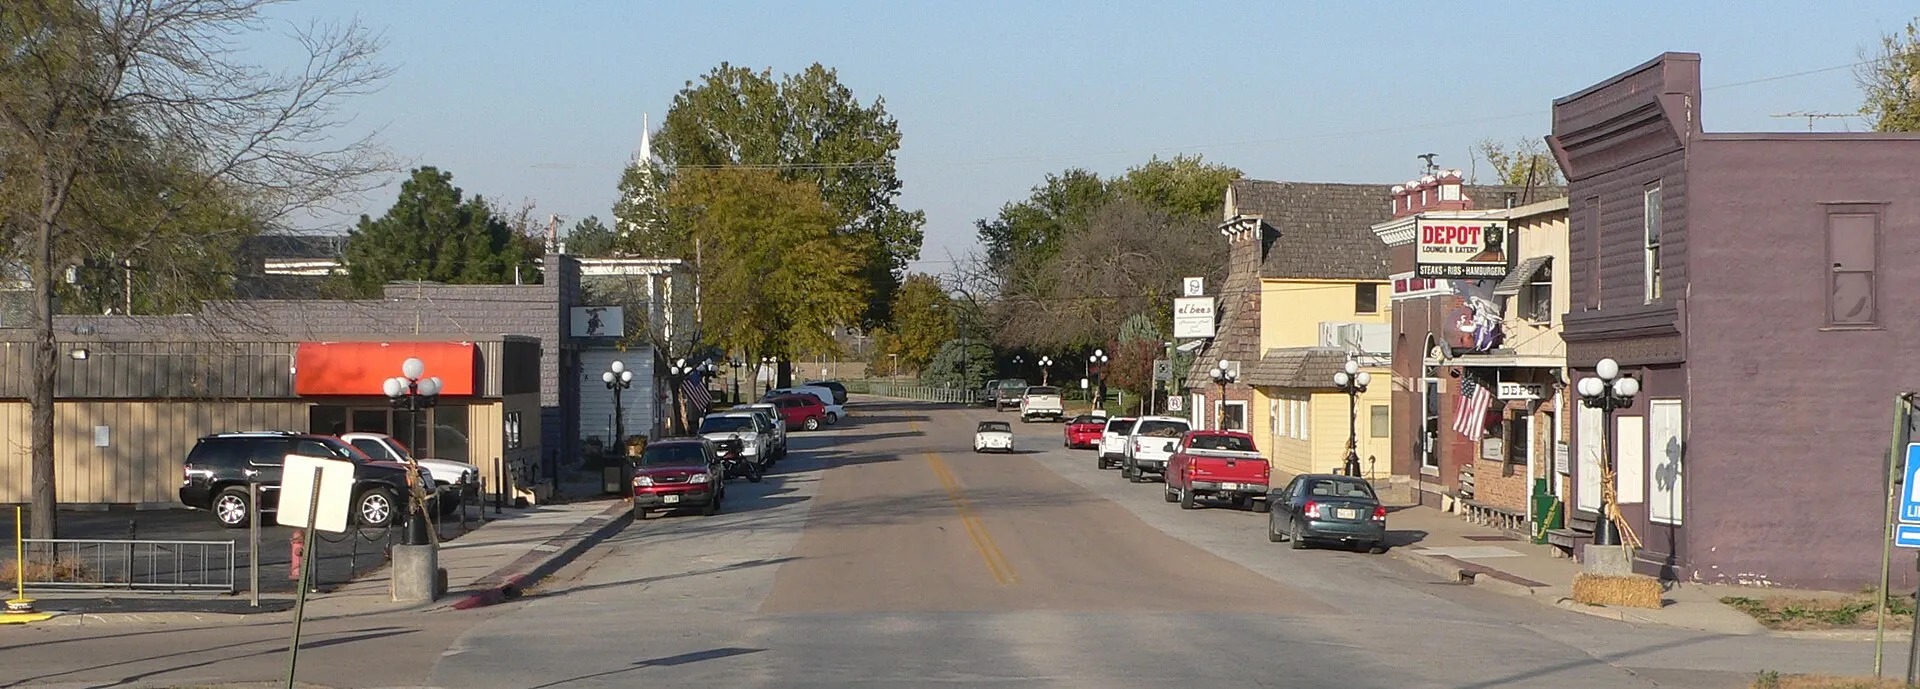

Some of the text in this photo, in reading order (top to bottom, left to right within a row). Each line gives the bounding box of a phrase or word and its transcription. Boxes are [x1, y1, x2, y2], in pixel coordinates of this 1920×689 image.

[1422, 226, 1481, 245] DEPOT
[1455, 246, 1478, 254] EATERY
[1420, 265, 1506, 276] STEAKS RIBS HAMBURGERS
[1502, 385, 1541, 395] DEPOT
[1907, 505, 1920, 517] LI
